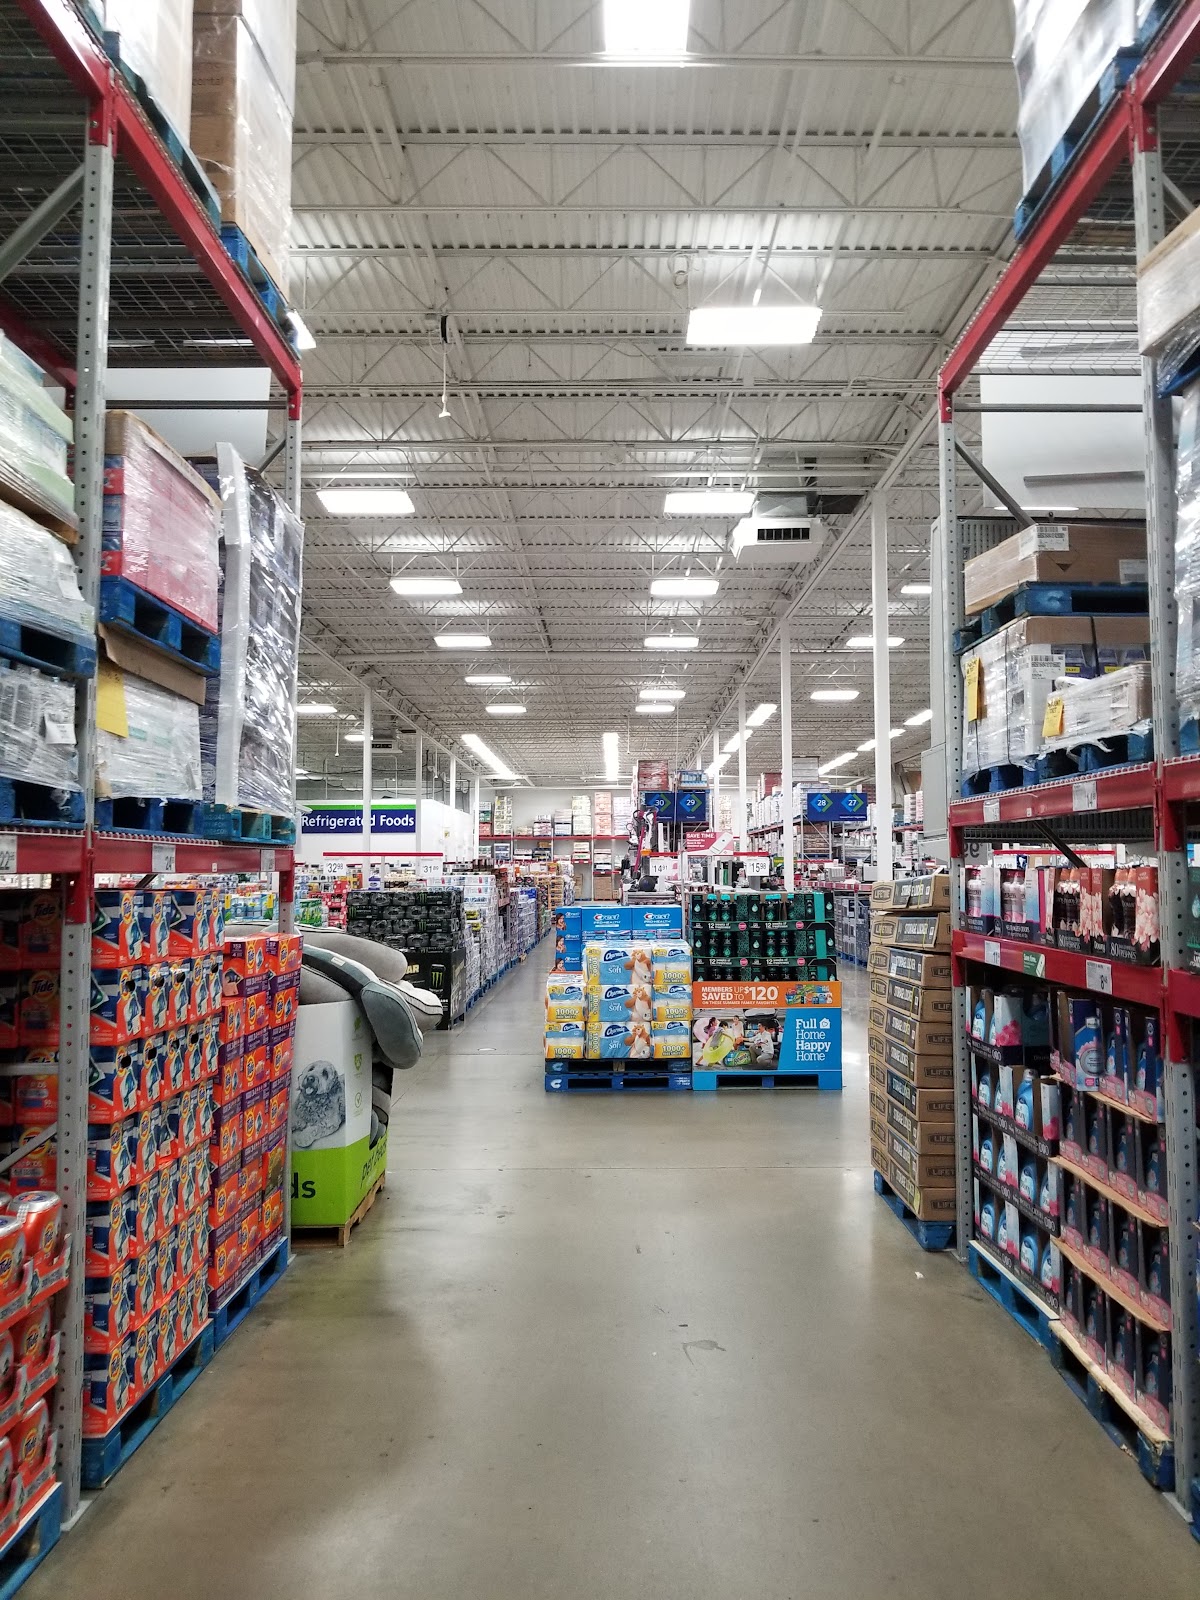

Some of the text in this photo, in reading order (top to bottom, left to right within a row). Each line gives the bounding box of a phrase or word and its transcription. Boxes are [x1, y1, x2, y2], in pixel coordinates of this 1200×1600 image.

[380, 814, 414, 826] Foods
[33, 904, 56, 919] Tide
[644, 912, 670, 920] Crest
[1110, 942, 1119, 957] 80
[32, 980, 55, 995] Tide
[605, 988, 626, 999] Charmin
[796, 1018, 816, 1029] Full
[605, 1026, 626, 1036] Charmin
[796, 1030, 825, 1039] Home
[796, 1041, 831, 1052] Happy
[796, 1051, 825, 1061] Home
